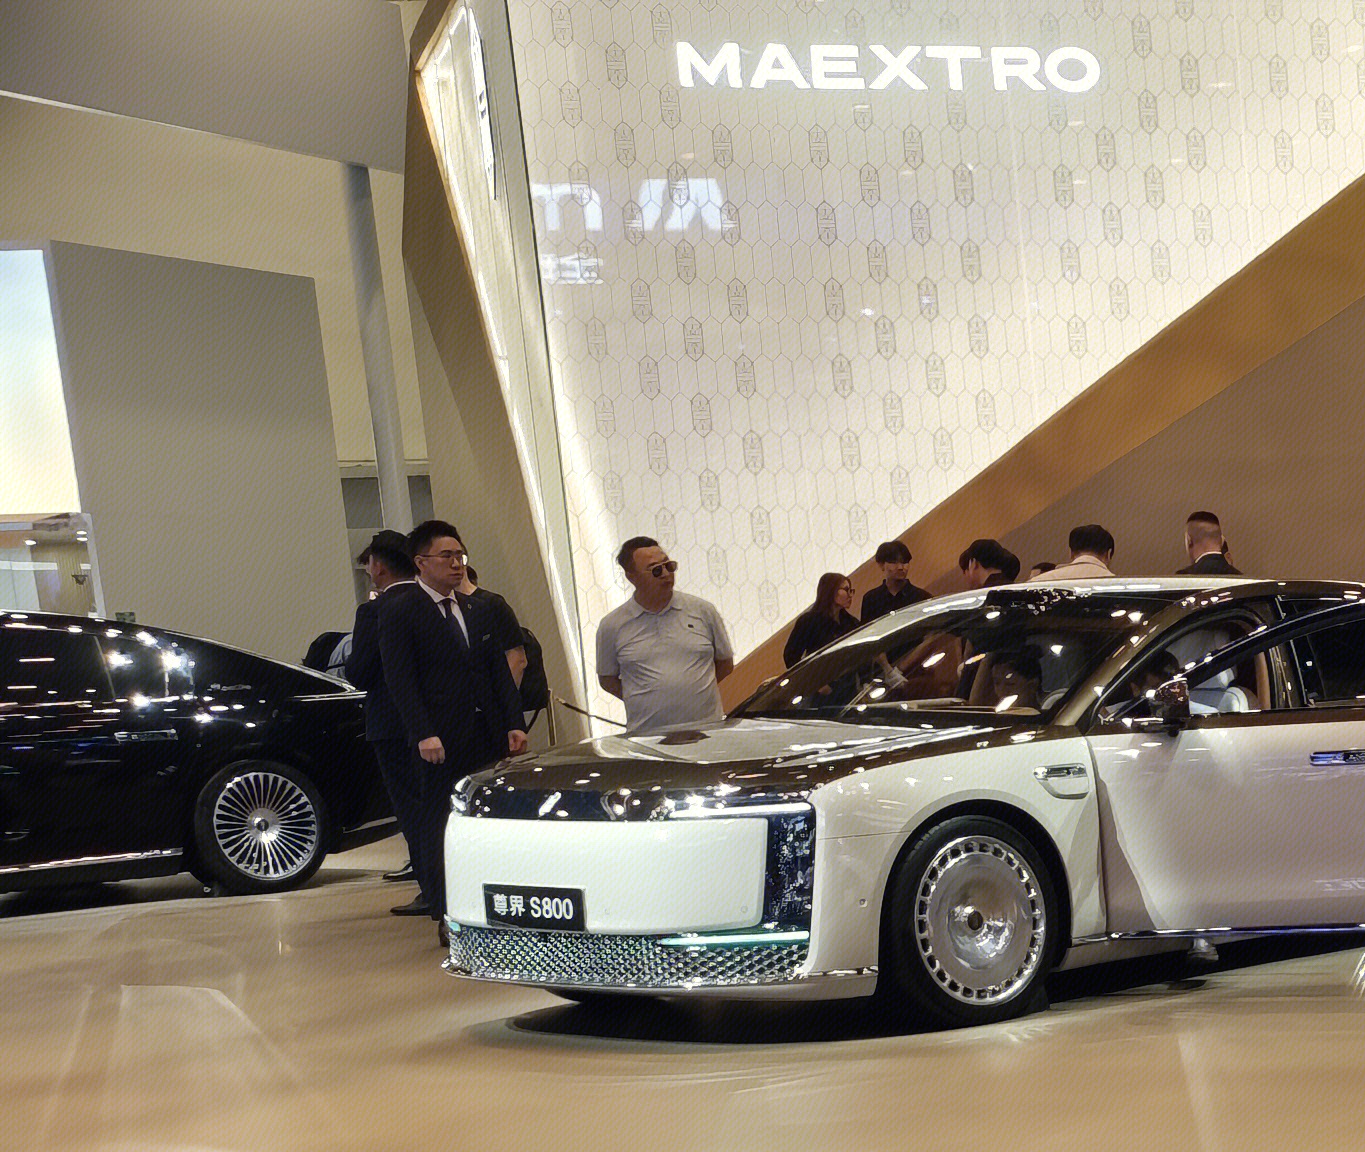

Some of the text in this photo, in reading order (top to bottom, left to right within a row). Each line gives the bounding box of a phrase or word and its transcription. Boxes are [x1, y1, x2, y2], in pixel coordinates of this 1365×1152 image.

[676, 42, 1101, 93] MAEXTRO
[493, 893, 574, 920] 尊界 S800
